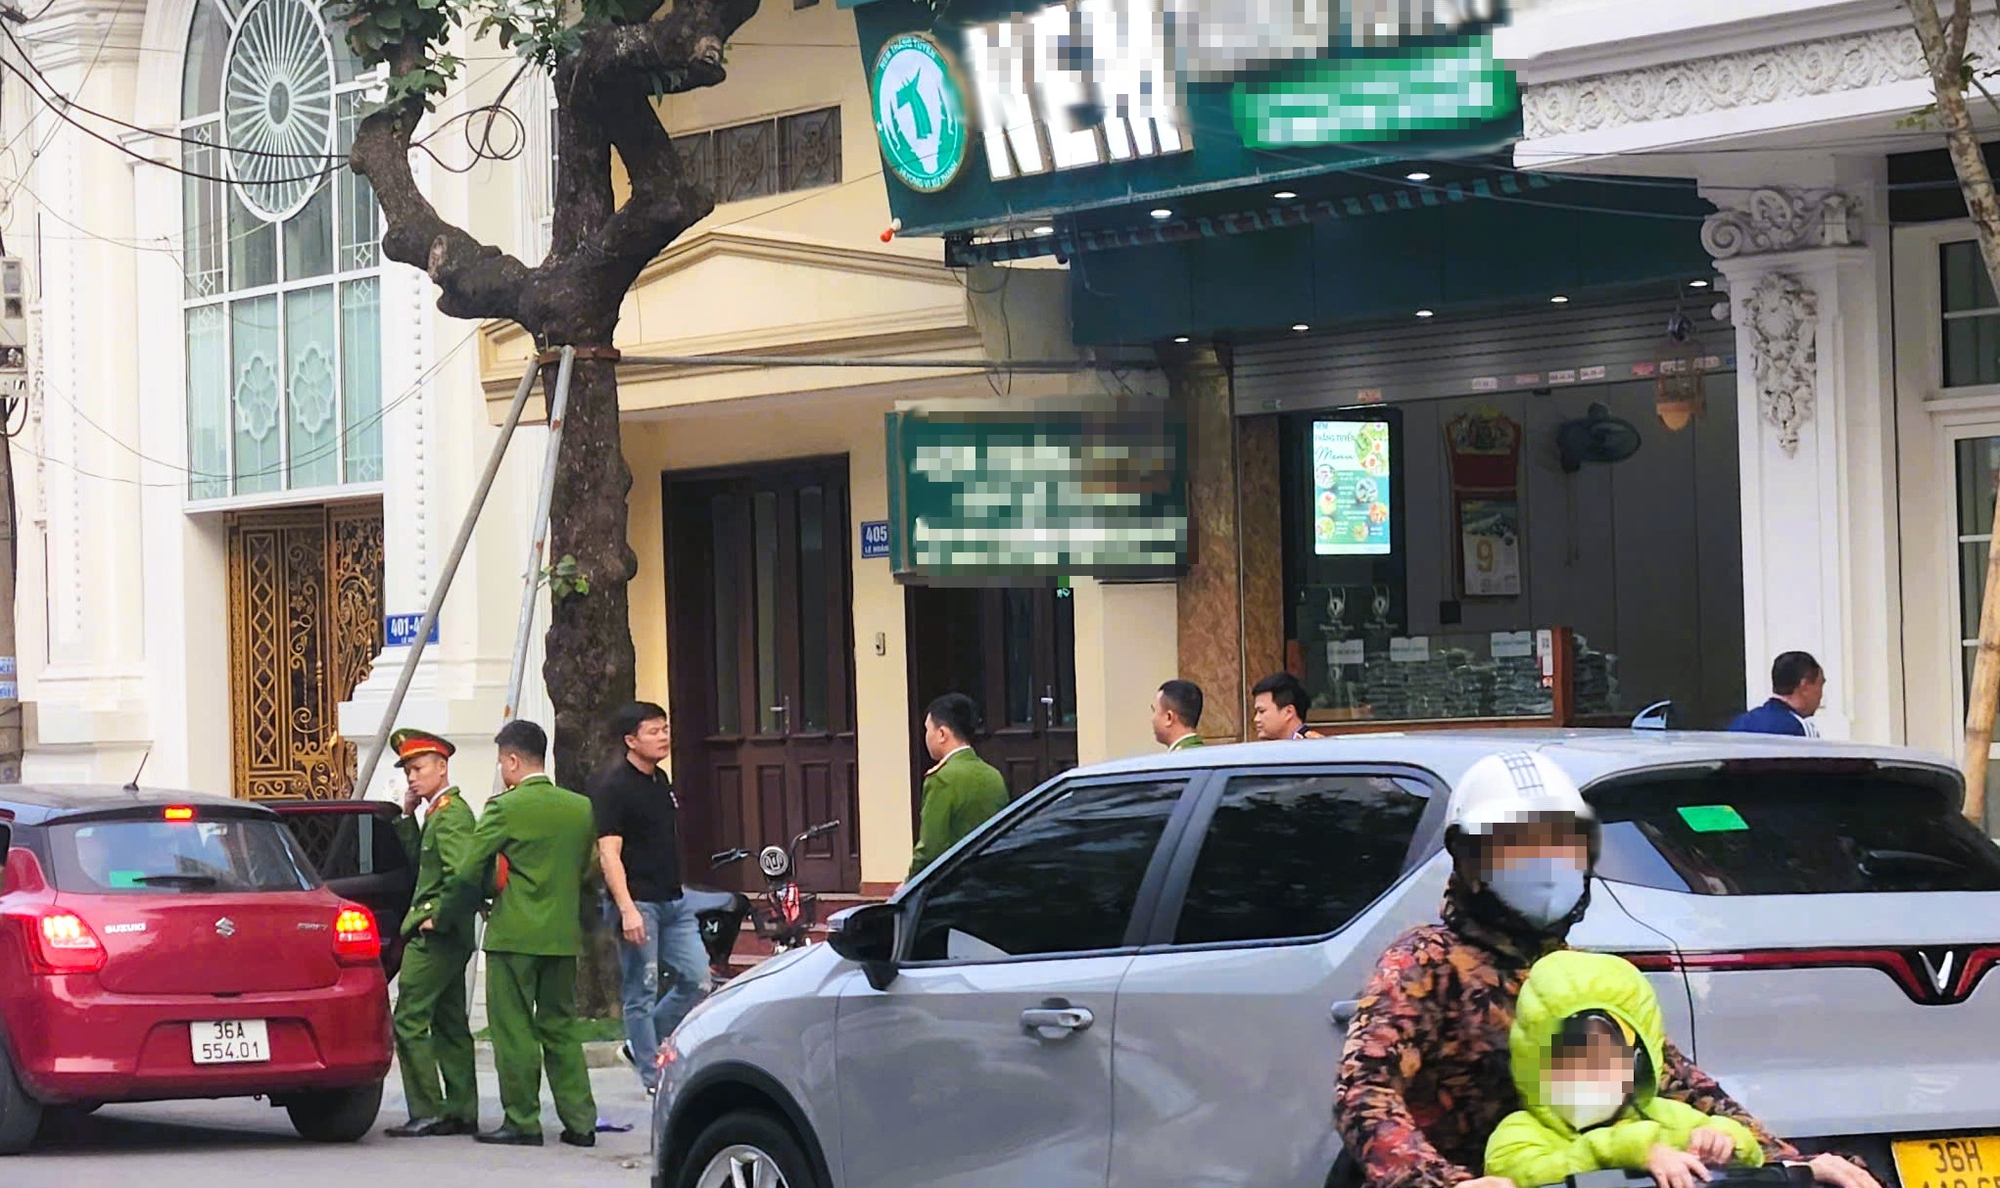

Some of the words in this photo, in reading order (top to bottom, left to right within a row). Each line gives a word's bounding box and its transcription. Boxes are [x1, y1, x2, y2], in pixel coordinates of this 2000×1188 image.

[865, 525, 888, 543] 405
[213, 1021, 246, 1040] 36A
[202, 1041, 259, 1060] 554.01
[1928, 1139, 1983, 1174] 36H
